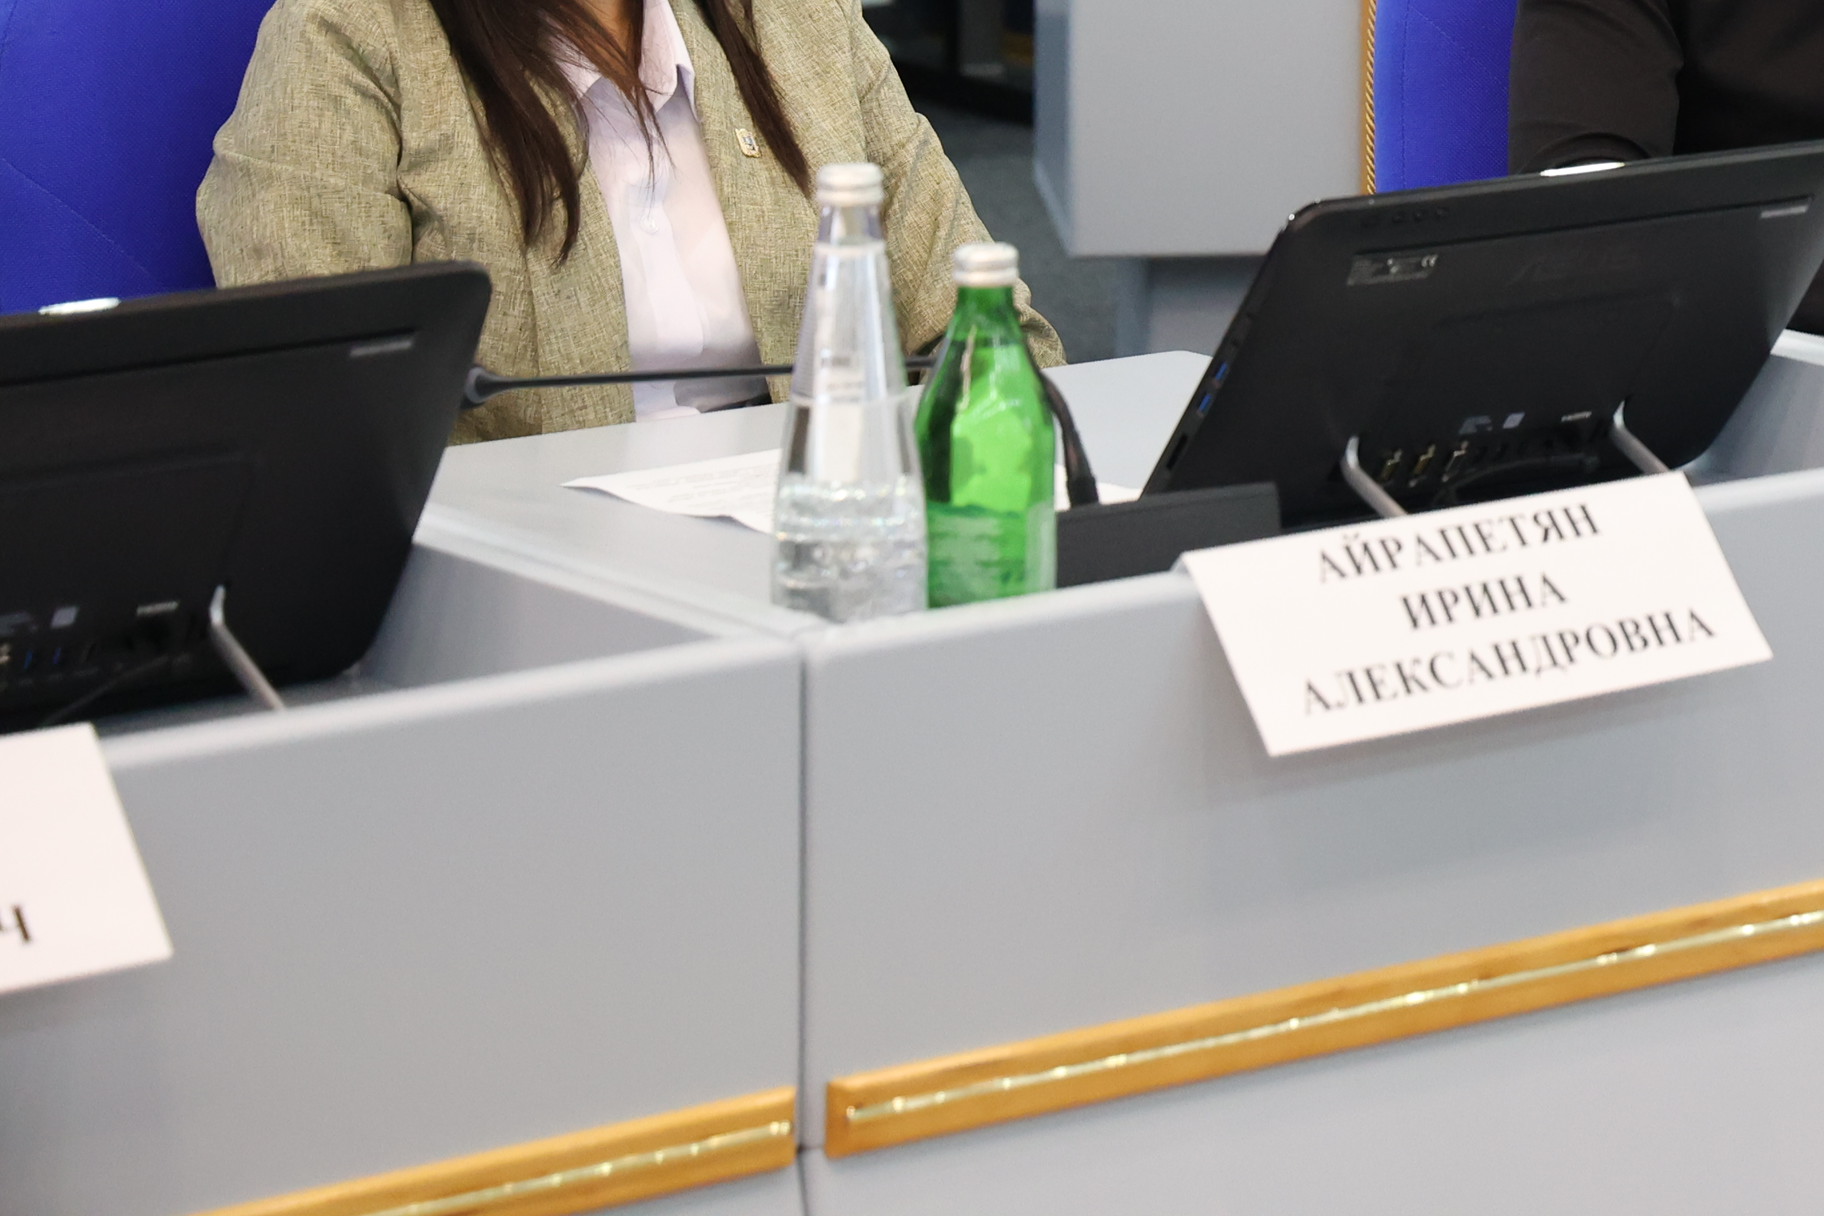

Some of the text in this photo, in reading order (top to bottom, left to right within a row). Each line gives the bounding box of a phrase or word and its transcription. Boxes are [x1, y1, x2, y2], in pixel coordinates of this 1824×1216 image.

[1318, 500, 1602, 585] АЙРАПЕТЯН
[1399, 571, 1568, 632] ИРИНА
[1301, 607, 1717, 717] АЛЕКСАНДРОВНА
